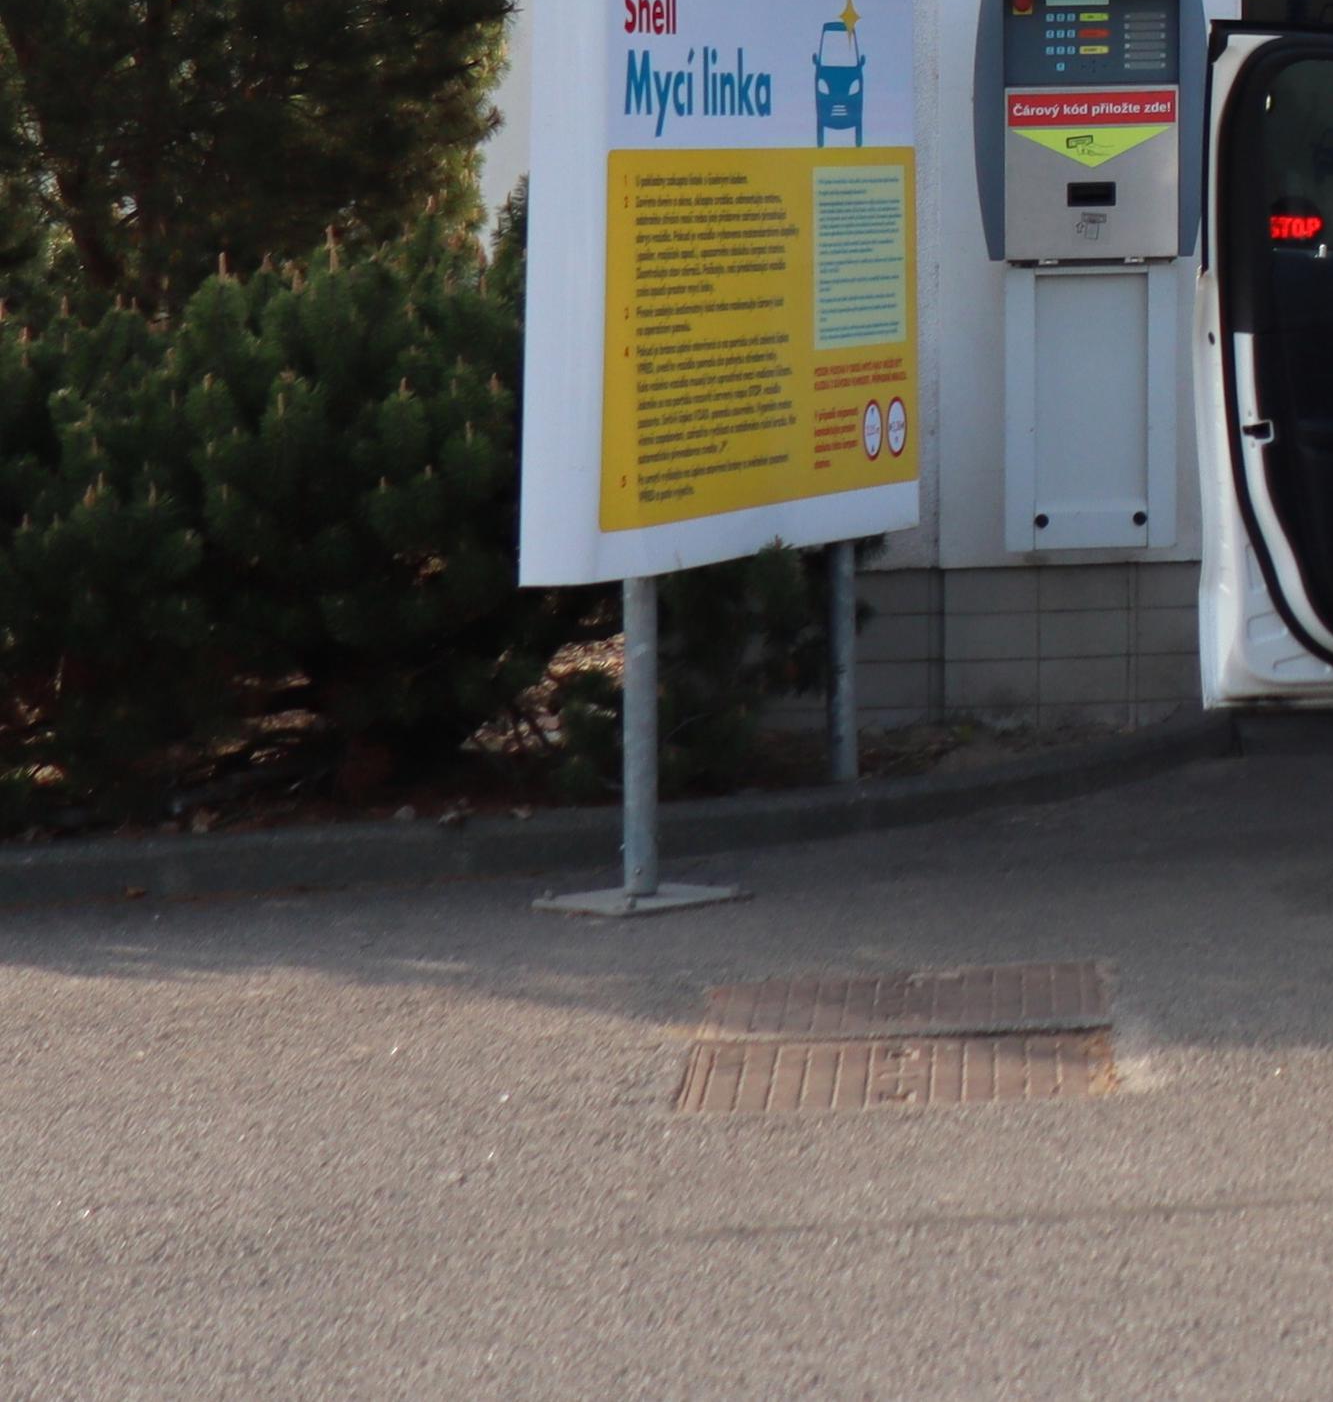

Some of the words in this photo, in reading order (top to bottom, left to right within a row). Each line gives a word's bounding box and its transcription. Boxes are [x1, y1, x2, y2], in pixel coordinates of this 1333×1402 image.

[624, 47, 695, 138] Mycí
[703, 46, 772, 117] linka
[1012, 102, 1060, 118] Čárový
[1063, 103, 1088, 115] kód
[1091, 101, 1141, 117] přiložte
[1144, 101, 1171, 113] zde!
[1269, 215, 1323, 239] STOP
